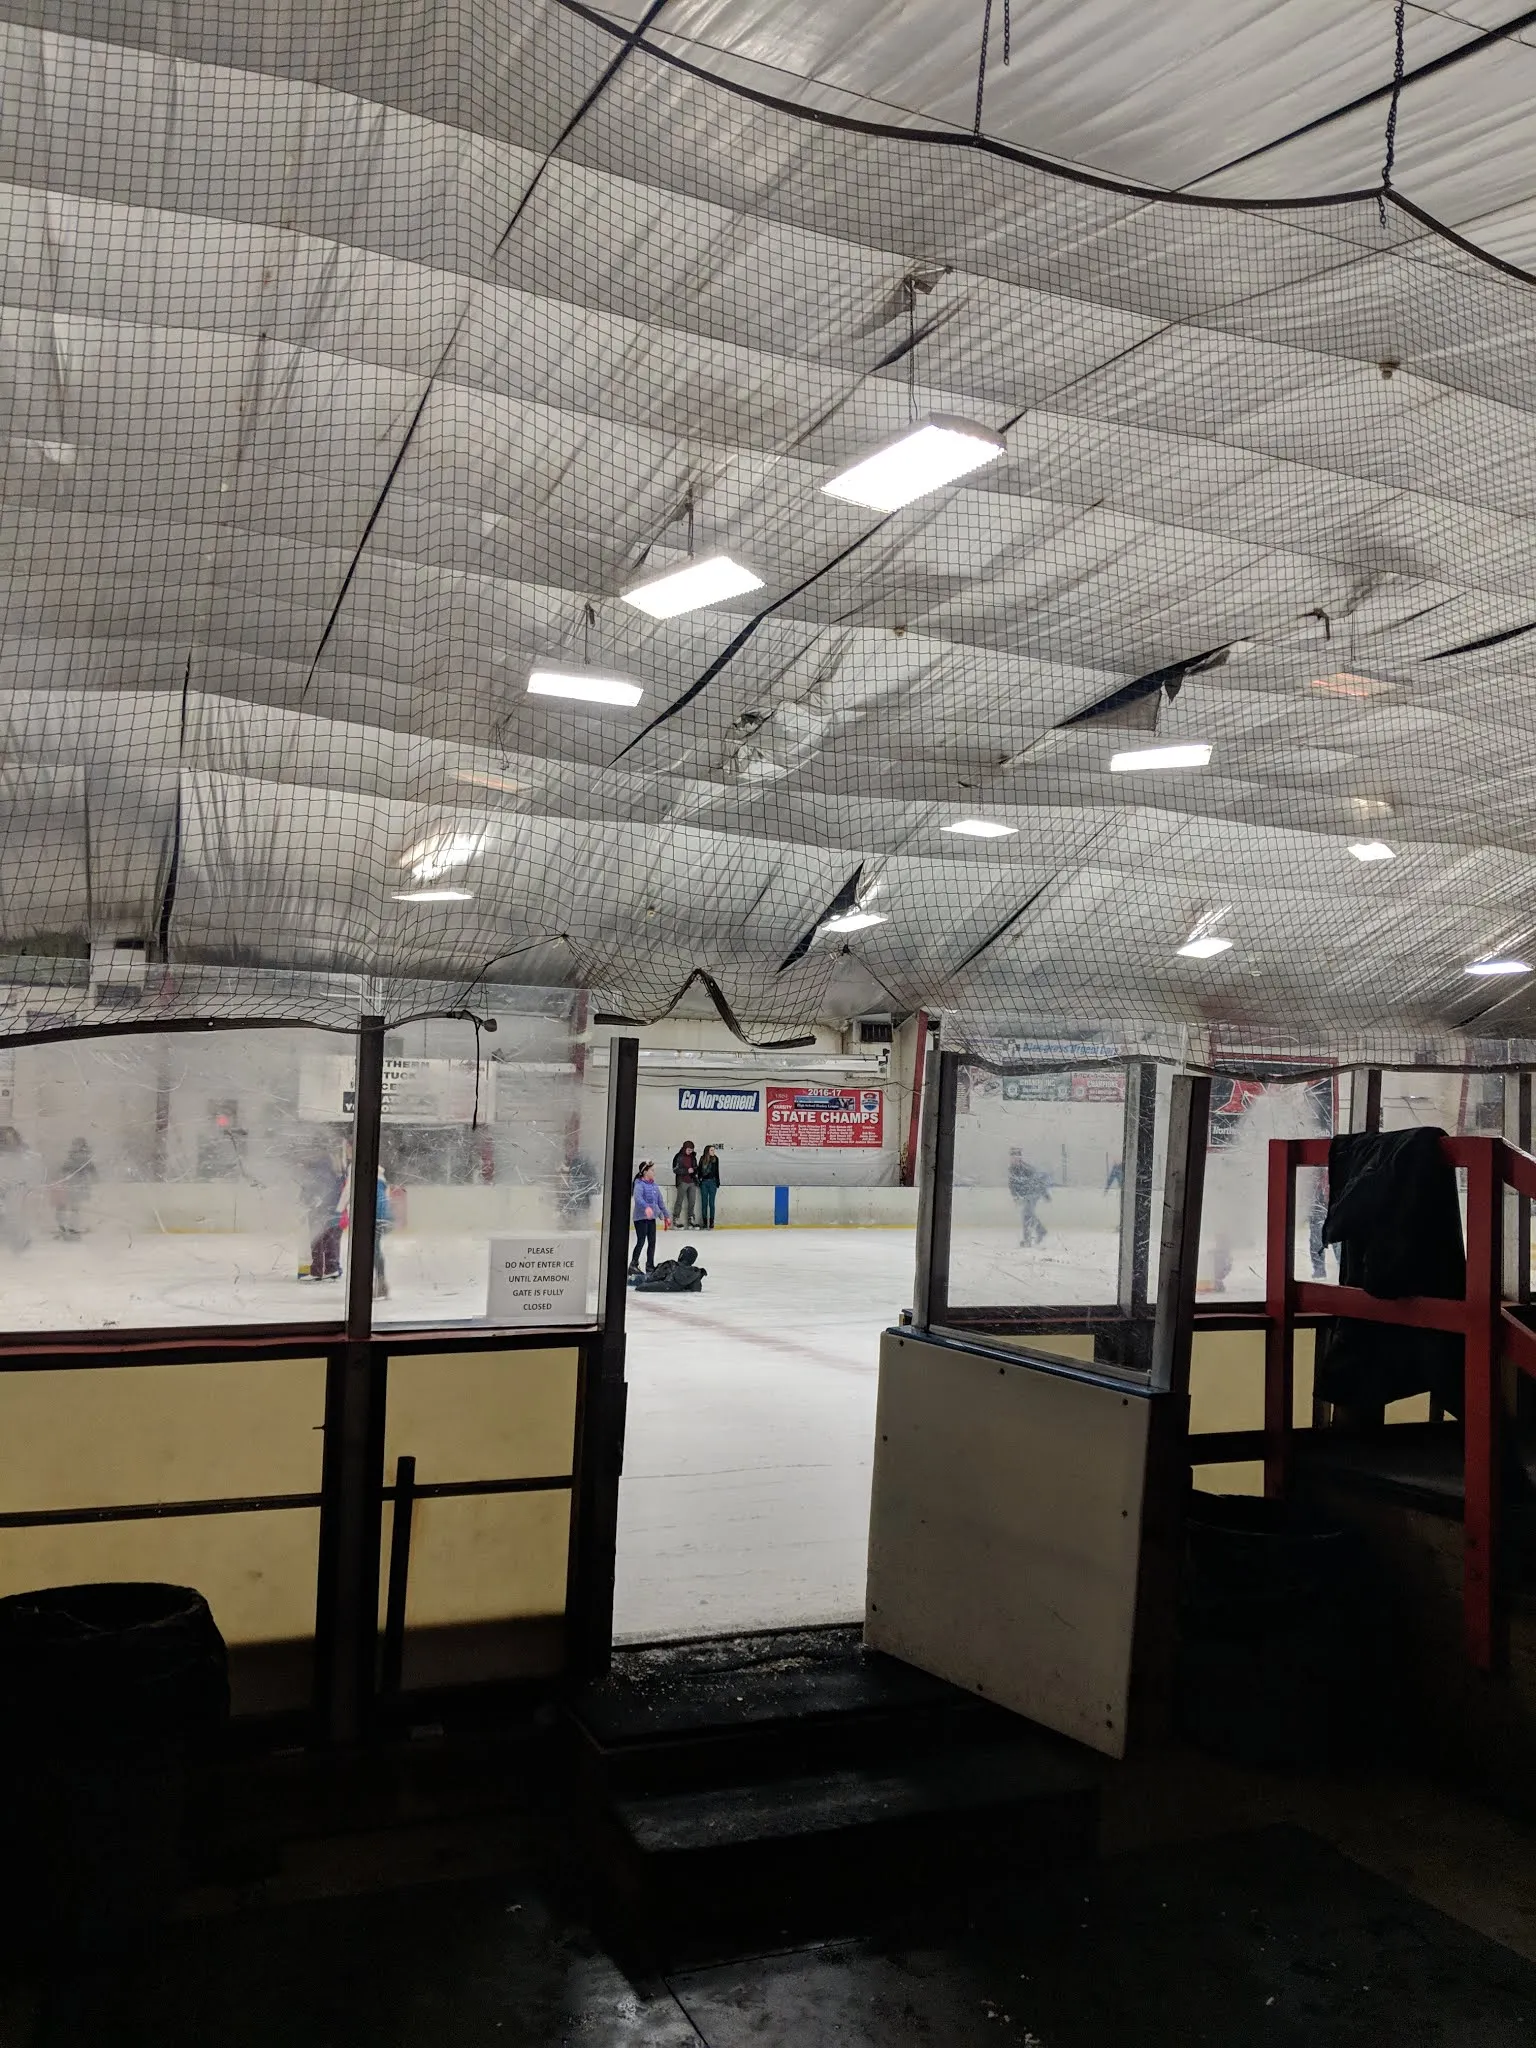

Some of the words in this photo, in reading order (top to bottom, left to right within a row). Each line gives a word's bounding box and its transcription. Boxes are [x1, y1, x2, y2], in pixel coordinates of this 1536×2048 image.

[680, 1091, 696, 1109] Go
[696, 1092, 757, 1110] Norsemen!
[771, 1111, 816, 1123] STATE
[820, 1112, 879, 1124] CHAMPS
[505, 1261, 517, 1269] DO
[563, 1260, 574, 1268] ICE
[508, 1275, 531, 1283] UNTIL
[523, 1303, 552, 1311] CLOSED
